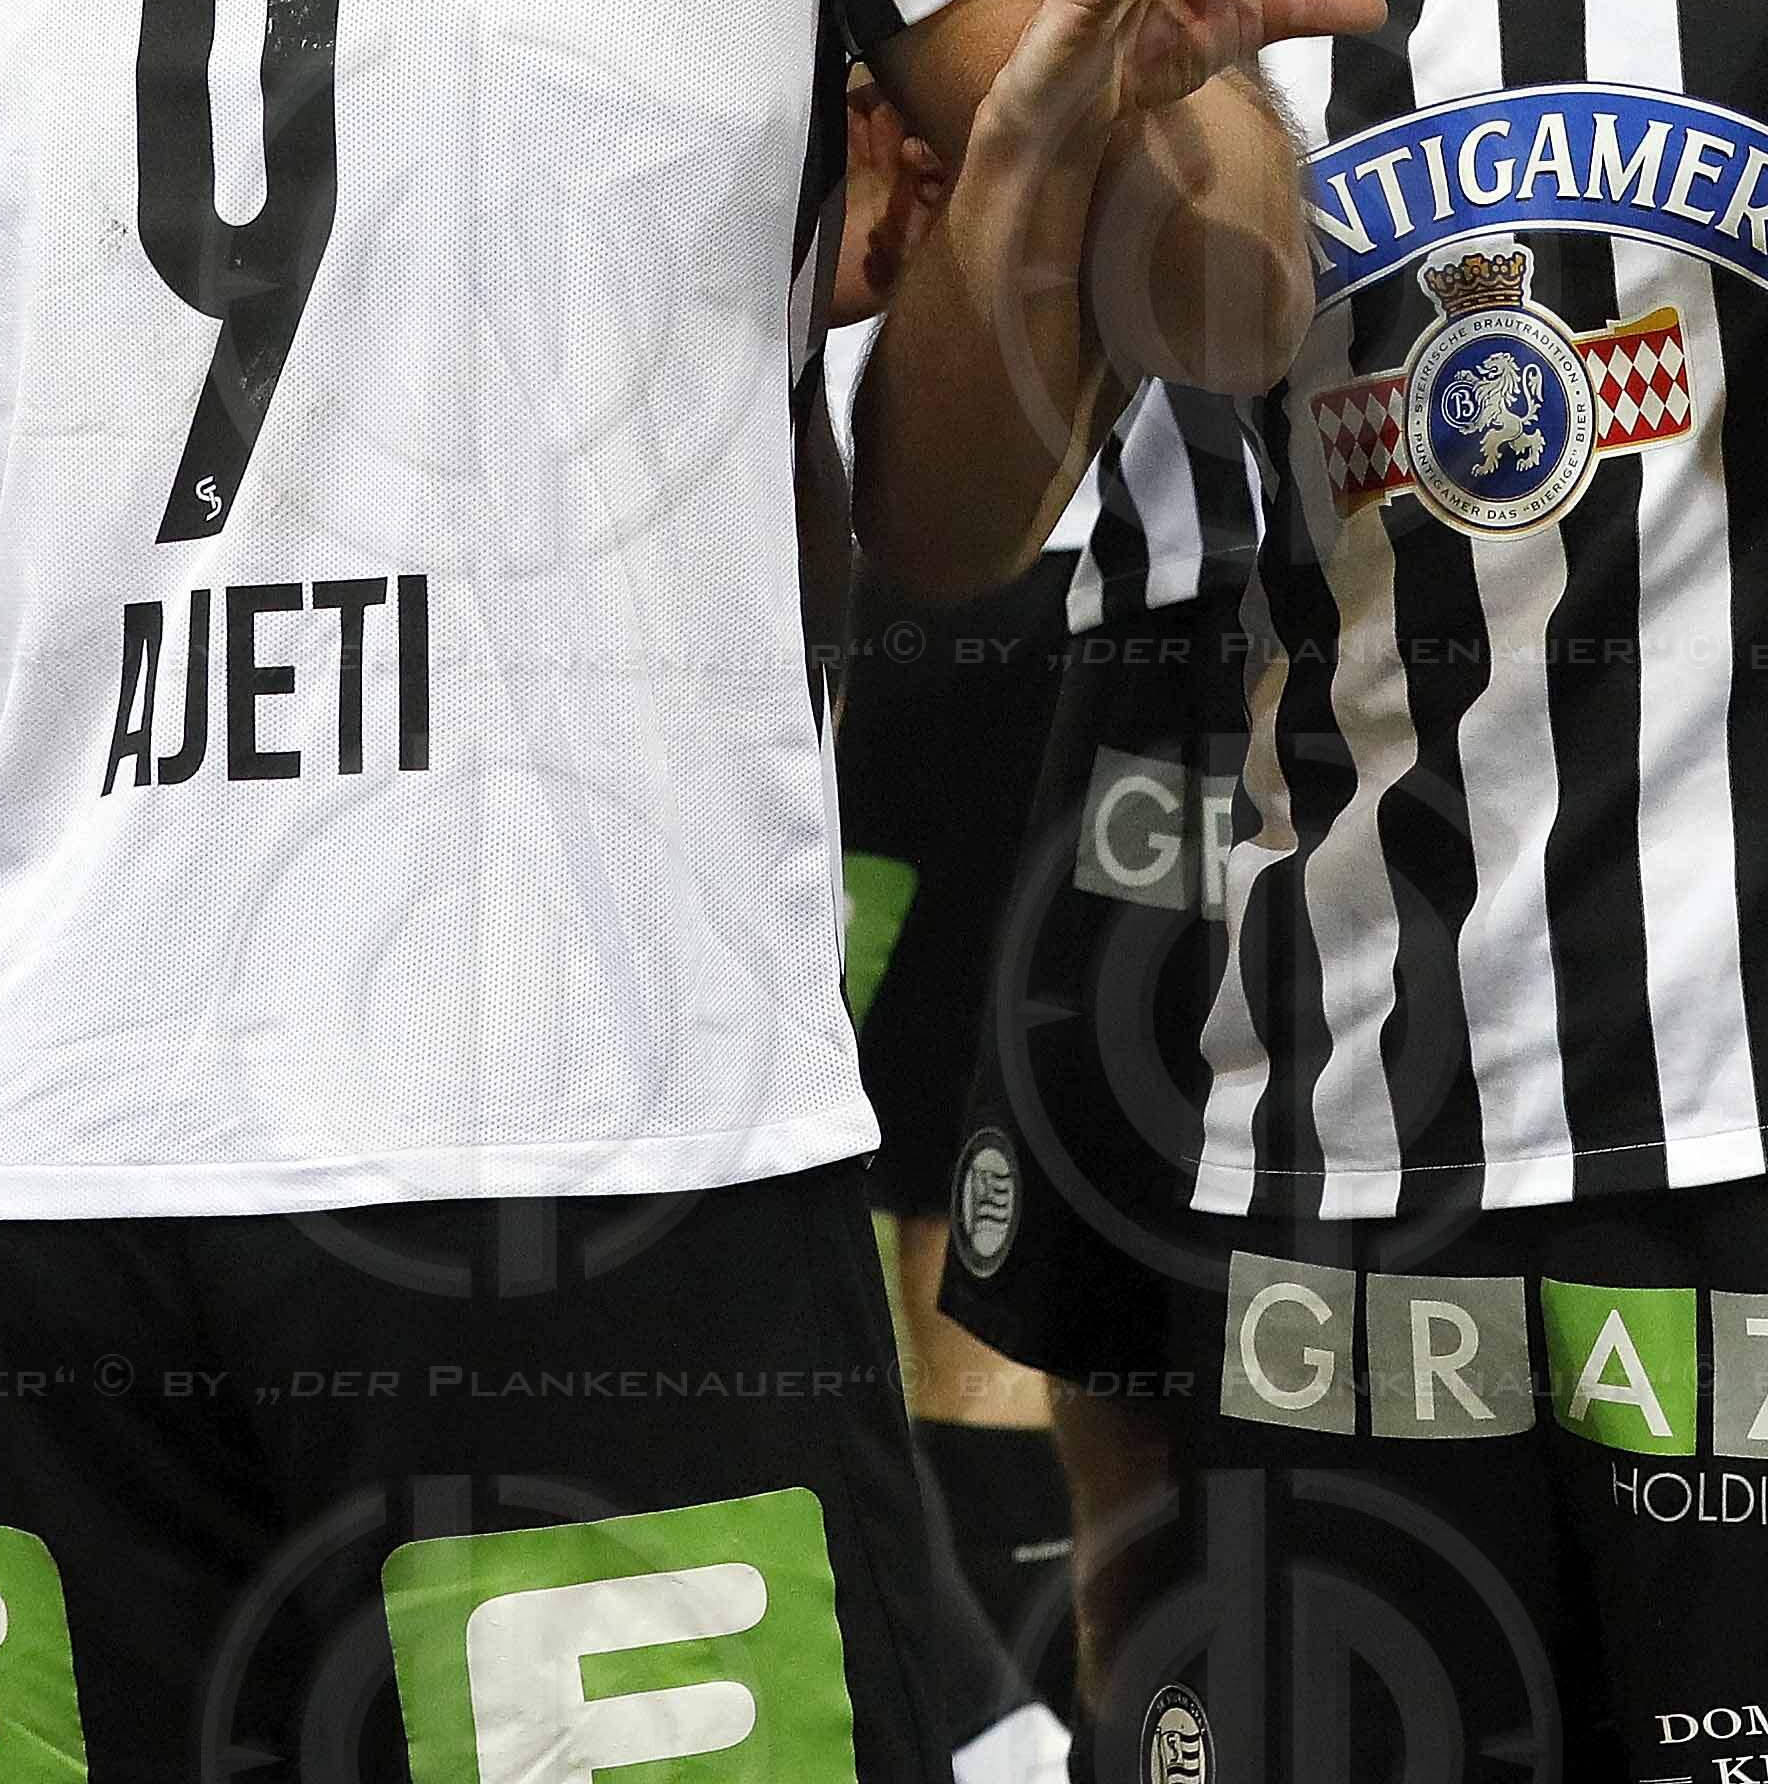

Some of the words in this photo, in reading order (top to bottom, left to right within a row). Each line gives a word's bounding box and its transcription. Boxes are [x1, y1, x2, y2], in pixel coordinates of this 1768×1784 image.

[1414, 327, 1468, 414] STEIRISCHE
[1473, 317, 1579, 385] BRAUTRADITION
[1414, 433, 1481, 517] PUNTIGAMER
[1487, 508, 1518, 520] DAS
[1576, 403, 1587, 444] BIER
[101, 574, 430, 797] AJETI
